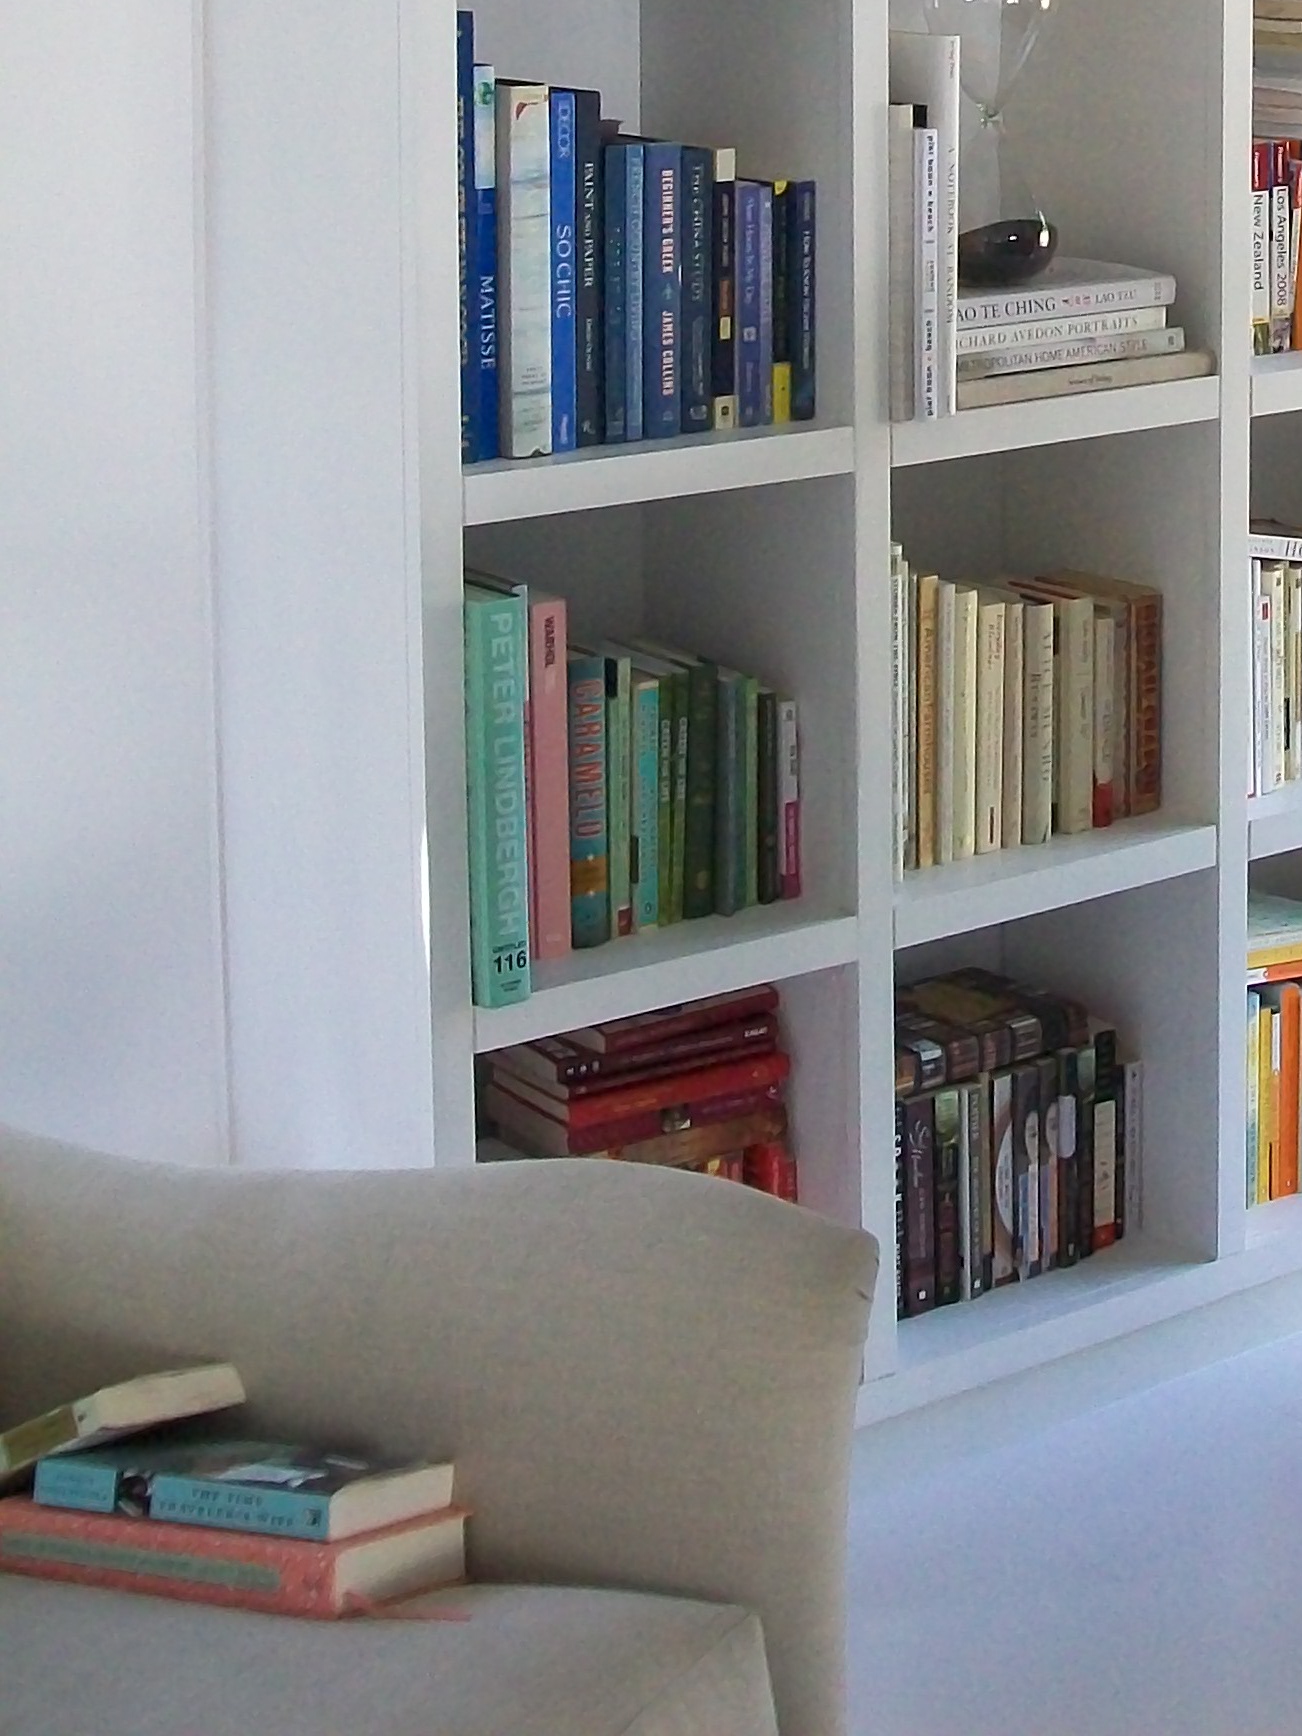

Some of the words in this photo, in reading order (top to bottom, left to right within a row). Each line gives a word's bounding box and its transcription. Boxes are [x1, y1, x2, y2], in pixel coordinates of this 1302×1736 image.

[584, 162, 595, 210] PAINT
[660, 169, 675, 235] BEGINNER'S
[1276, 188, 1287, 212] Los
[1253, 194, 1263, 230] New
[555, 223, 573, 260] SO
[584, 238, 595, 288] PAPER
[661, 237, 675, 274] GREEK
[1253, 232, 1264, 291] Zealand
[1274, 215, 1289, 269] Angeles
[555, 263, 573, 319] CHIC
[980, 304, 1001, 319] TE
[1004, 297, 1057, 316] CHING
[1095, 292, 1116, 304] LAO
[1276, 273, 1288, 307] 2008
[479, 274, 497, 370] MATISSE
[661, 310, 674, 346] JAMES
[1013, 325, 1063, 343] AVEDON
[1067, 316, 1138, 335] PORTRAITS
[661, 349, 674, 397] COLLINS
[1034, 348, 1063, 363] HOME
[1065, 343, 1117, 359] AMERICAN
[543, 615, 556, 670] WARHOL
[488, 612, 517, 728] PETER
[573, 679, 605, 839] CARAMELO
[493, 735, 522, 935] LINDBERGH
[493, 949, 527, 974] 116
